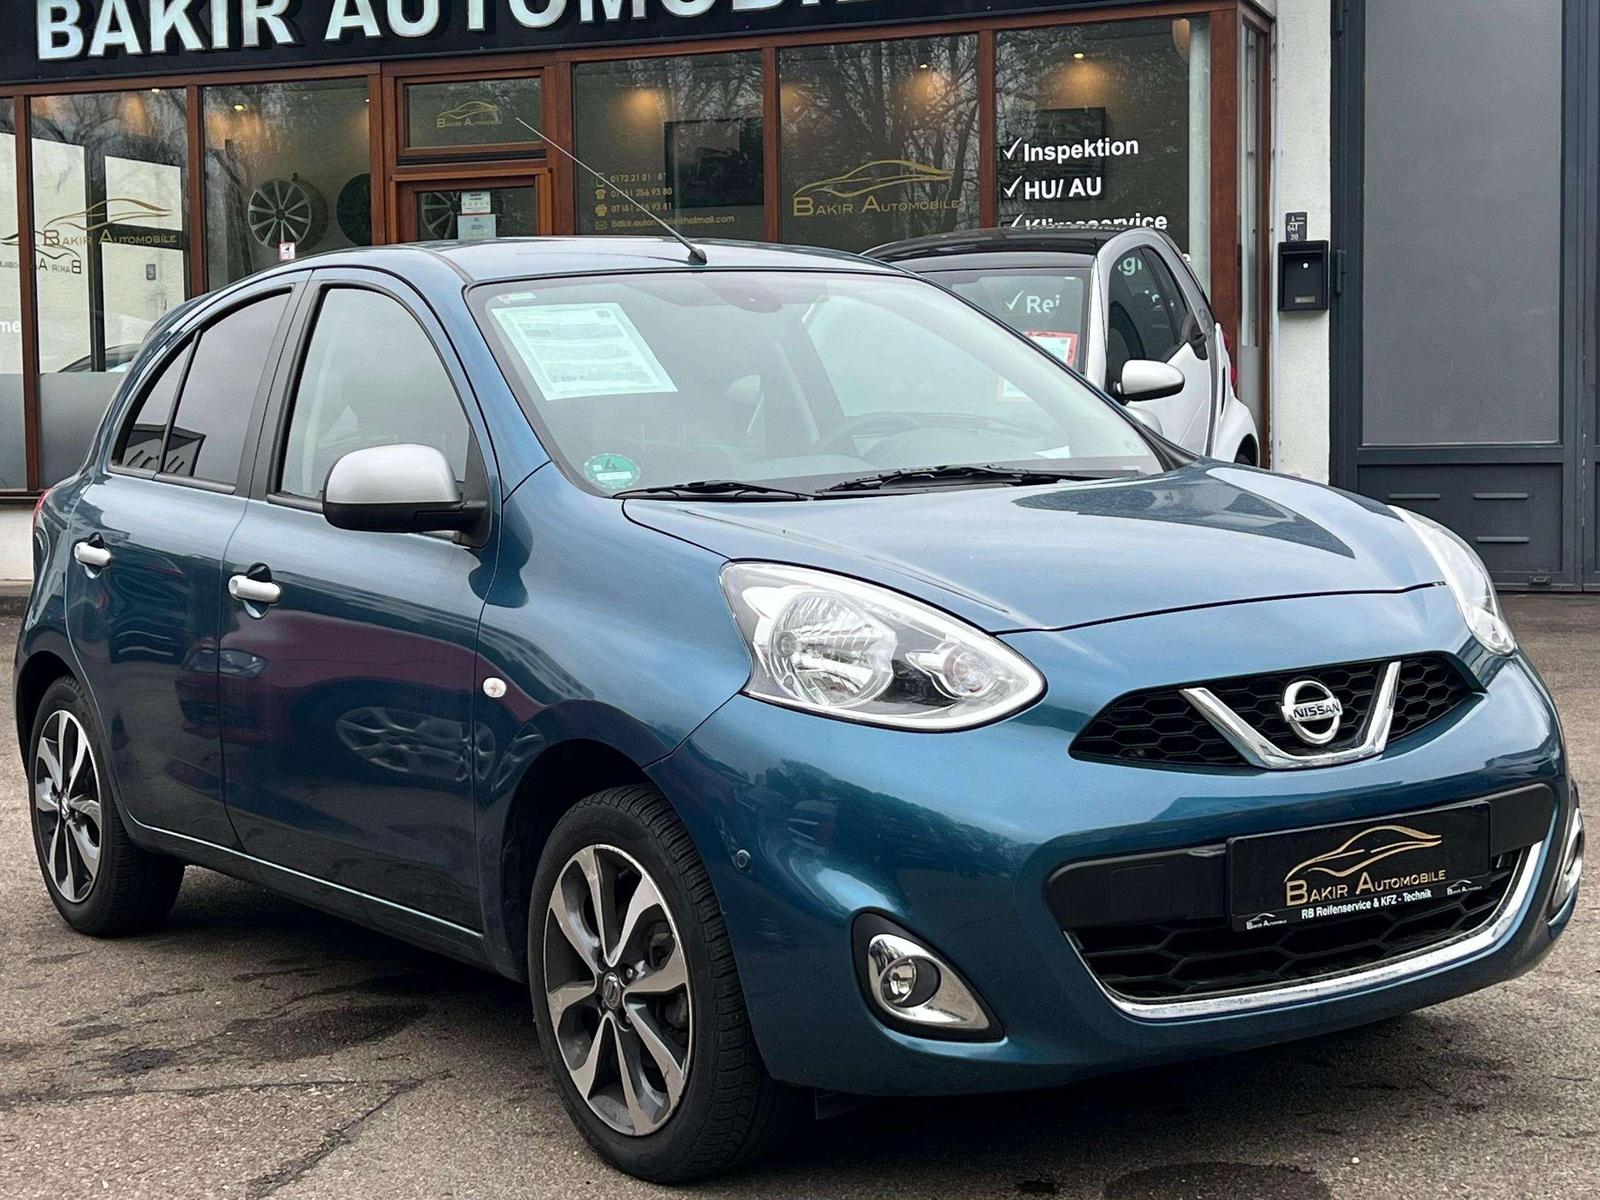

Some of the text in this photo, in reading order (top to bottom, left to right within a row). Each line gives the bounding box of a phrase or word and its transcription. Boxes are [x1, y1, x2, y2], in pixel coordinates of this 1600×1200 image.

[36, 0, 295, 60] BAKIR
[1023, 137, 1139, 164] Inspektion
[1024, 177, 1102, 200] HU/ AU
[793, 195, 962, 216] BAKIR AUTOMOBILE
[1293, 703, 1340, 718] NISSAN
[1286, 870, 1446, 906] BAKIR AUTOMOBILE
[1301, 907, 1315, 920] RB
[1316, 899, 1372, 917] Reifenservice
[1373, 897, 1380, 908] &
[1380, 894, 1397, 906] KFZ
[1402, 889, 1432, 902] Technik
